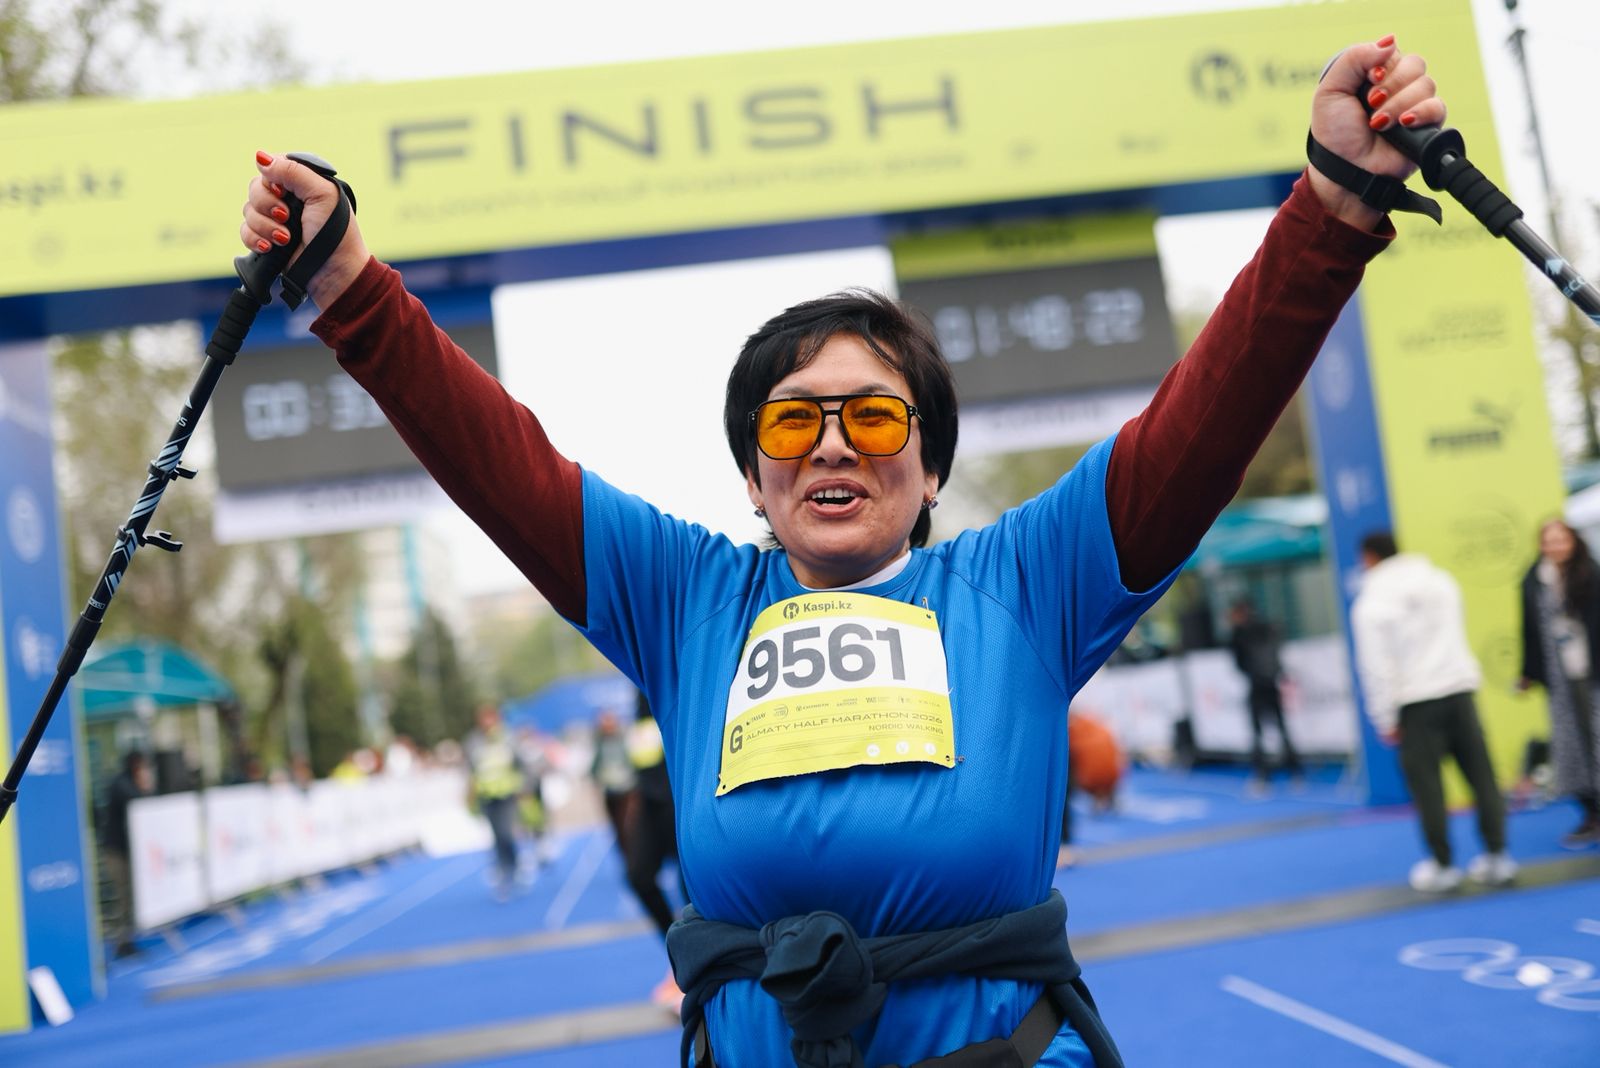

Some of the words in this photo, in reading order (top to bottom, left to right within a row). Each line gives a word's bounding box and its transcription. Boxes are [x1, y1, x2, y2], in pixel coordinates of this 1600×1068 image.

[387, 75, 963, 184] FINISH
[803, 600, 852, 613] Kaspi.kz
[747, 623, 906, 700] 9561
[730, 724, 743, 754] G
[746, 723, 791, 741] ALMATY
[793, 718, 829, 728] HALF
[832, 711, 909, 723] MARATHON
[911, 713, 943, 724] 2026
[868, 723, 903, 732] NORDIC
[905, 722, 944, 735] WALKING
